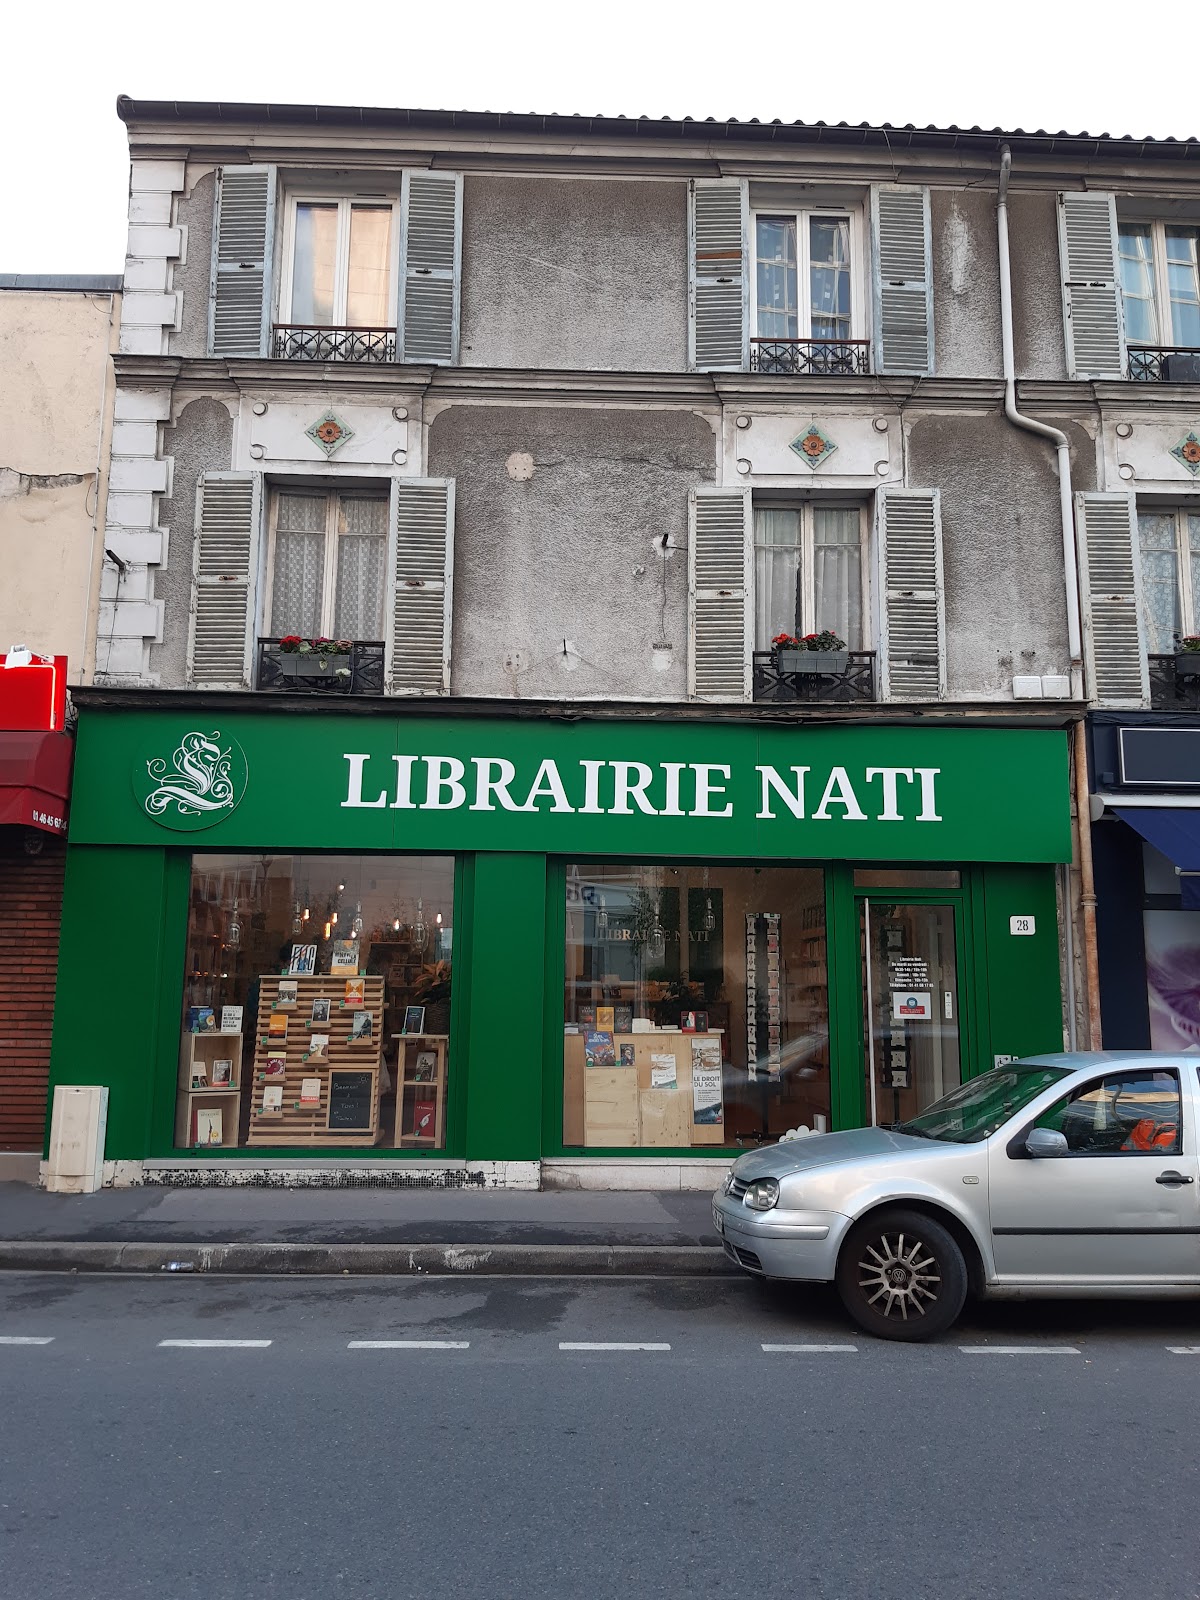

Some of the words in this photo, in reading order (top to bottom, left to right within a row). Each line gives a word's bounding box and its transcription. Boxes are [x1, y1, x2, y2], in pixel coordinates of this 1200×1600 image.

[340, 753, 733, 817] LIBRAIRIE
[755, 765, 943, 822] NATI
[1016, 920, 1029, 931] 28
